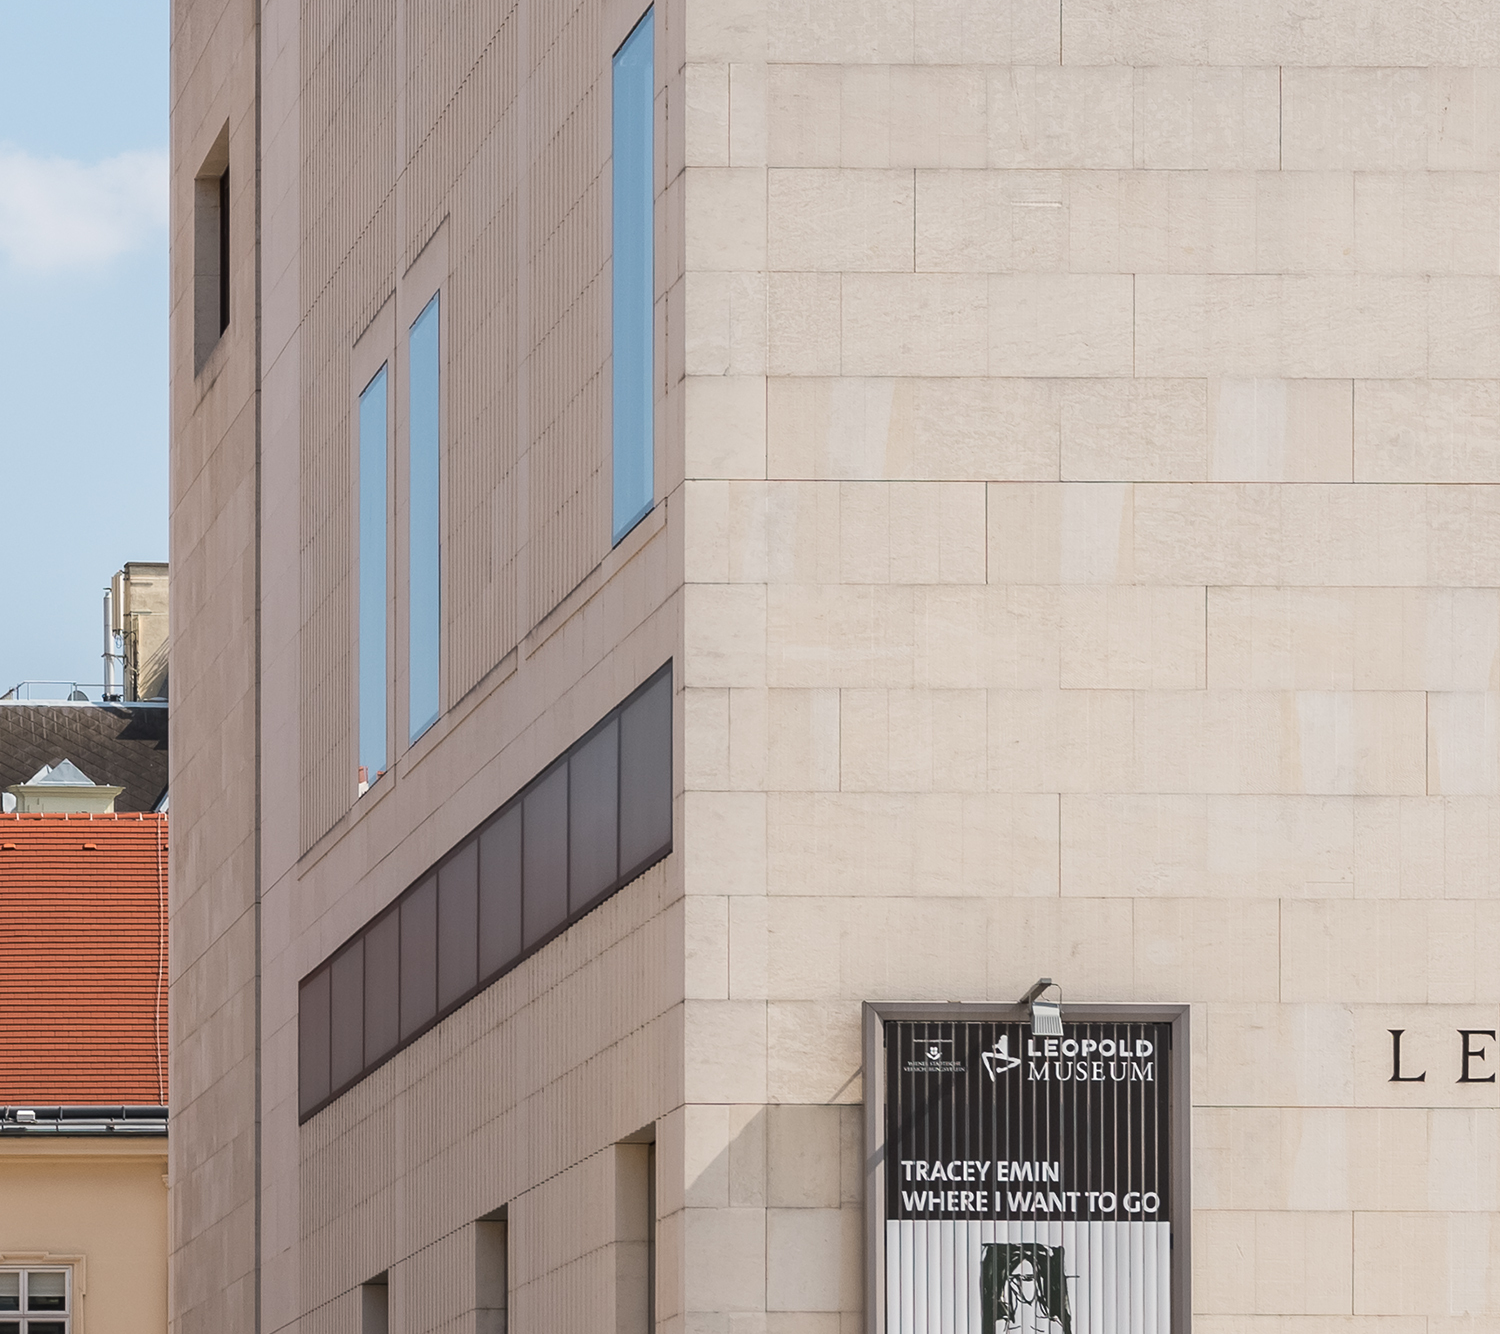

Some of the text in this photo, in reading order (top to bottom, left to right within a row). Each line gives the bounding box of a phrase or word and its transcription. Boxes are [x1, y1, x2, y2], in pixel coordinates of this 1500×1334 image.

[1027, 1039, 1154, 1057] LEOPOLD
[1027, 1061, 1154, 1081] MUSEUM
[901, 1160, 1059, 1182] TRACEY EMIN
[901, 1190, 1160, 1212] WHERE I WANT TO GO
